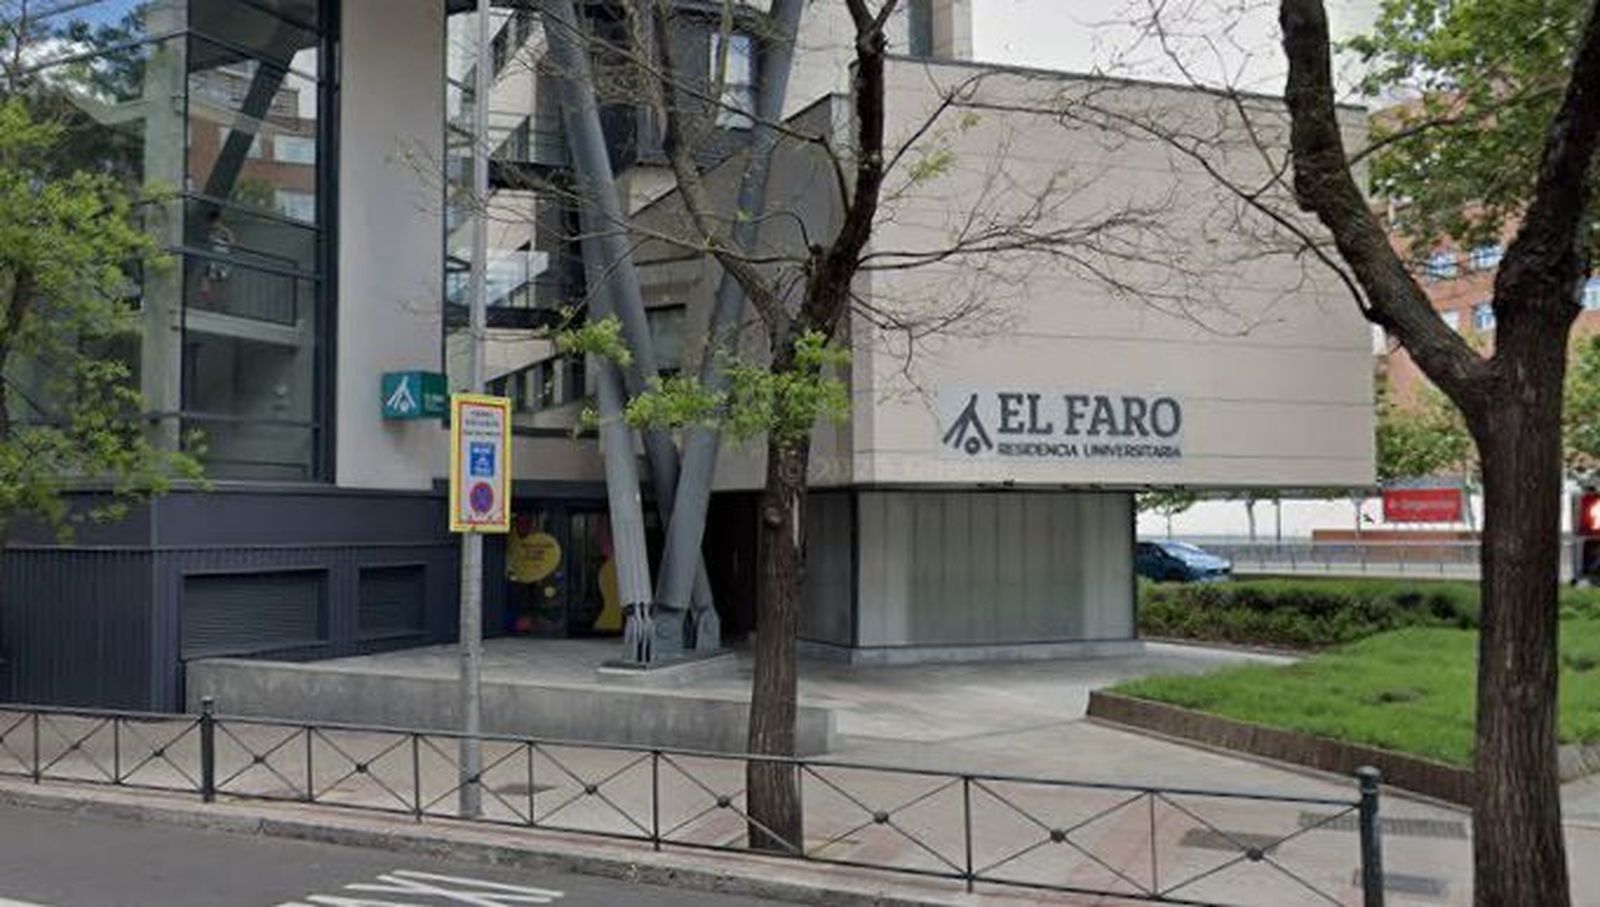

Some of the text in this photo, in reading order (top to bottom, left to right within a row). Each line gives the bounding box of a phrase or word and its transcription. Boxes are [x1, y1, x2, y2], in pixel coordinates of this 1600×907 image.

[997, 392, 1182, 438] EL FARO
[997, 442, 1182, 459] RESIDENCIA UNIVERSITARIA
